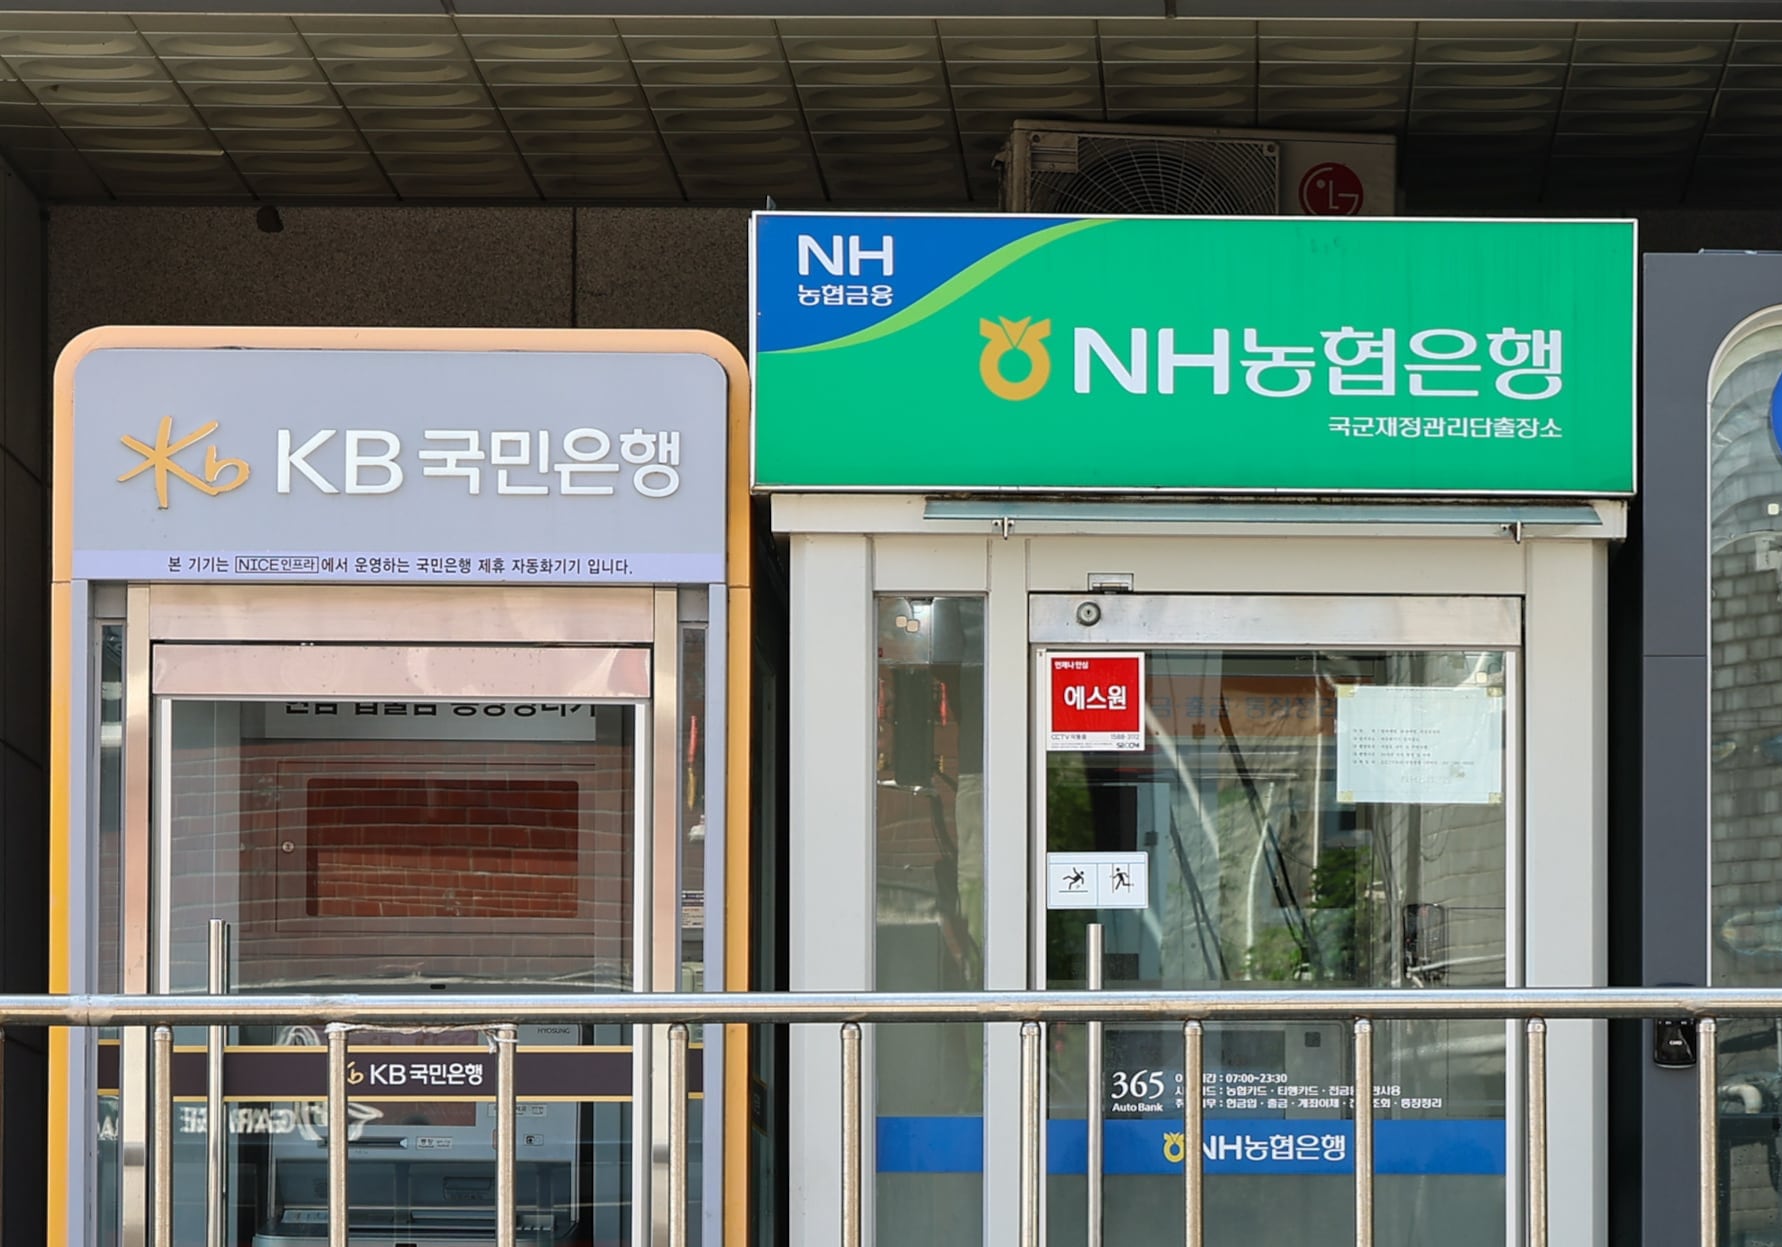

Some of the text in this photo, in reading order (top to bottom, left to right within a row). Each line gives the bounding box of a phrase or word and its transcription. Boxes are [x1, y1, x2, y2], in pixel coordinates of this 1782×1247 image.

[796, 233, 894, 277] NH
[796, 284, 894, 309] 농협금융
[1074, 325, 1564, 400] NH농협은행
[1328, 416, 1563, 440] 국군재정관리단출장소
[276, 428, 404, 496] KB
[417, 427, 682, 499] 국민은행
[168, 556, 182, 573] 본
[188, 556, 230, 573] 기기는
[354, 556, 410, 574] 운영하는
[415, 556, 472, 574] 국민은행
[477, 556, 506, 574] 제휴
[510, 557, 582, 575] 자동화기기
[586, 557, 634, 576] 입니다.
[1063, 684, 1127, 711] 에스원
[369, 1062, 484, 1087] KB 국민은행
[1111, 1068, 1165, 1100] 365
[1225, 1073, 1288, 1084] 07:00~23:30
[1111, 1102, 1164, 1113] Auto Bank
[1267, 1098, 1288, 1109] 출금
[1297, 1098, 1340, 1109] 계좌이체
[1400, 1098, 1443, 1109] 통장정리
